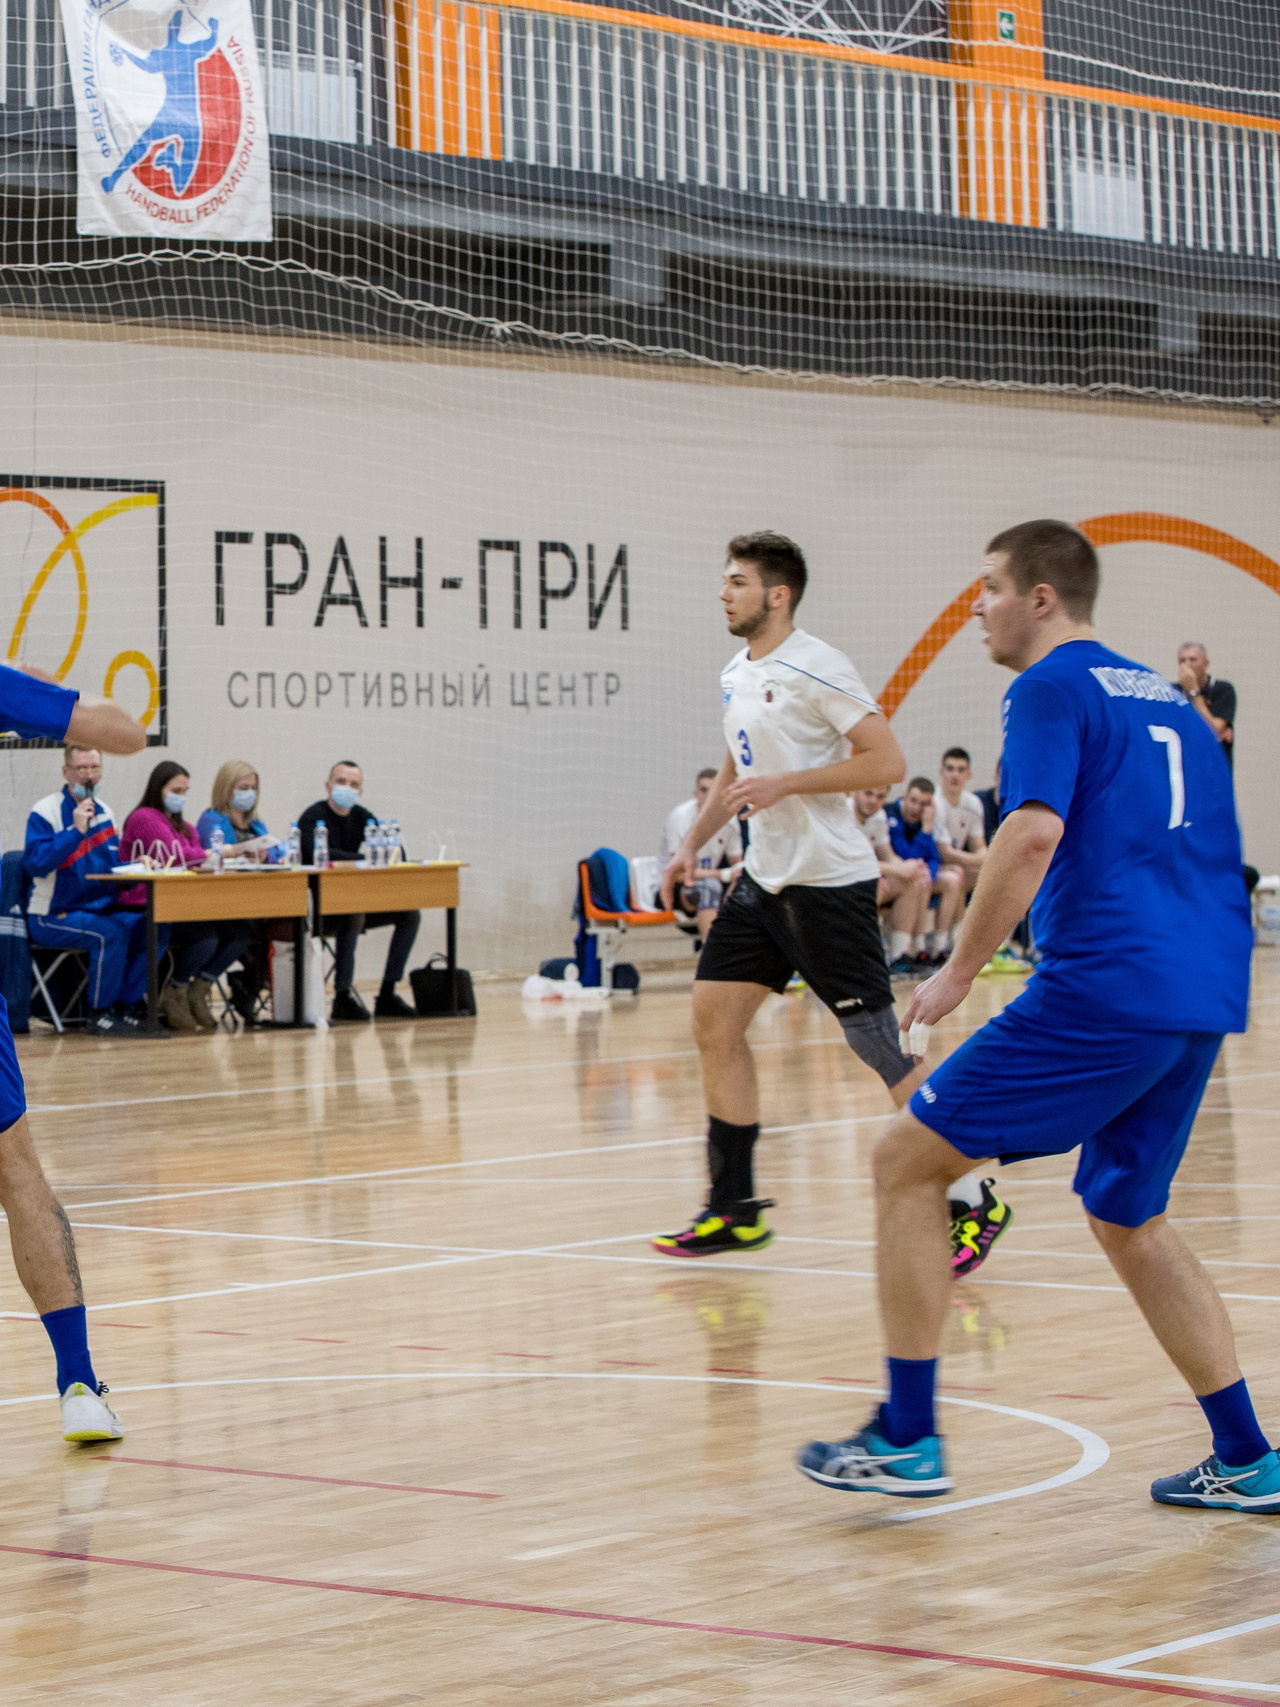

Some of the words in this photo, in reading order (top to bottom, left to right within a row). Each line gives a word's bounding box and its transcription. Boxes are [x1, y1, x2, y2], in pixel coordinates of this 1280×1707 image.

[125, 183, 194, 224] HANDBALL
[196, 137, 254, 221] FEDERATION
[245, 114, 256, 135] OF
[214, 530, 629, 631] ГРАН-ПРИ
[227, 663, 491, 709] СПОРТИВНЫЙ
[510, 671, 621, 713] ЦЕНТР
[737, 729, 753, 767] 3
